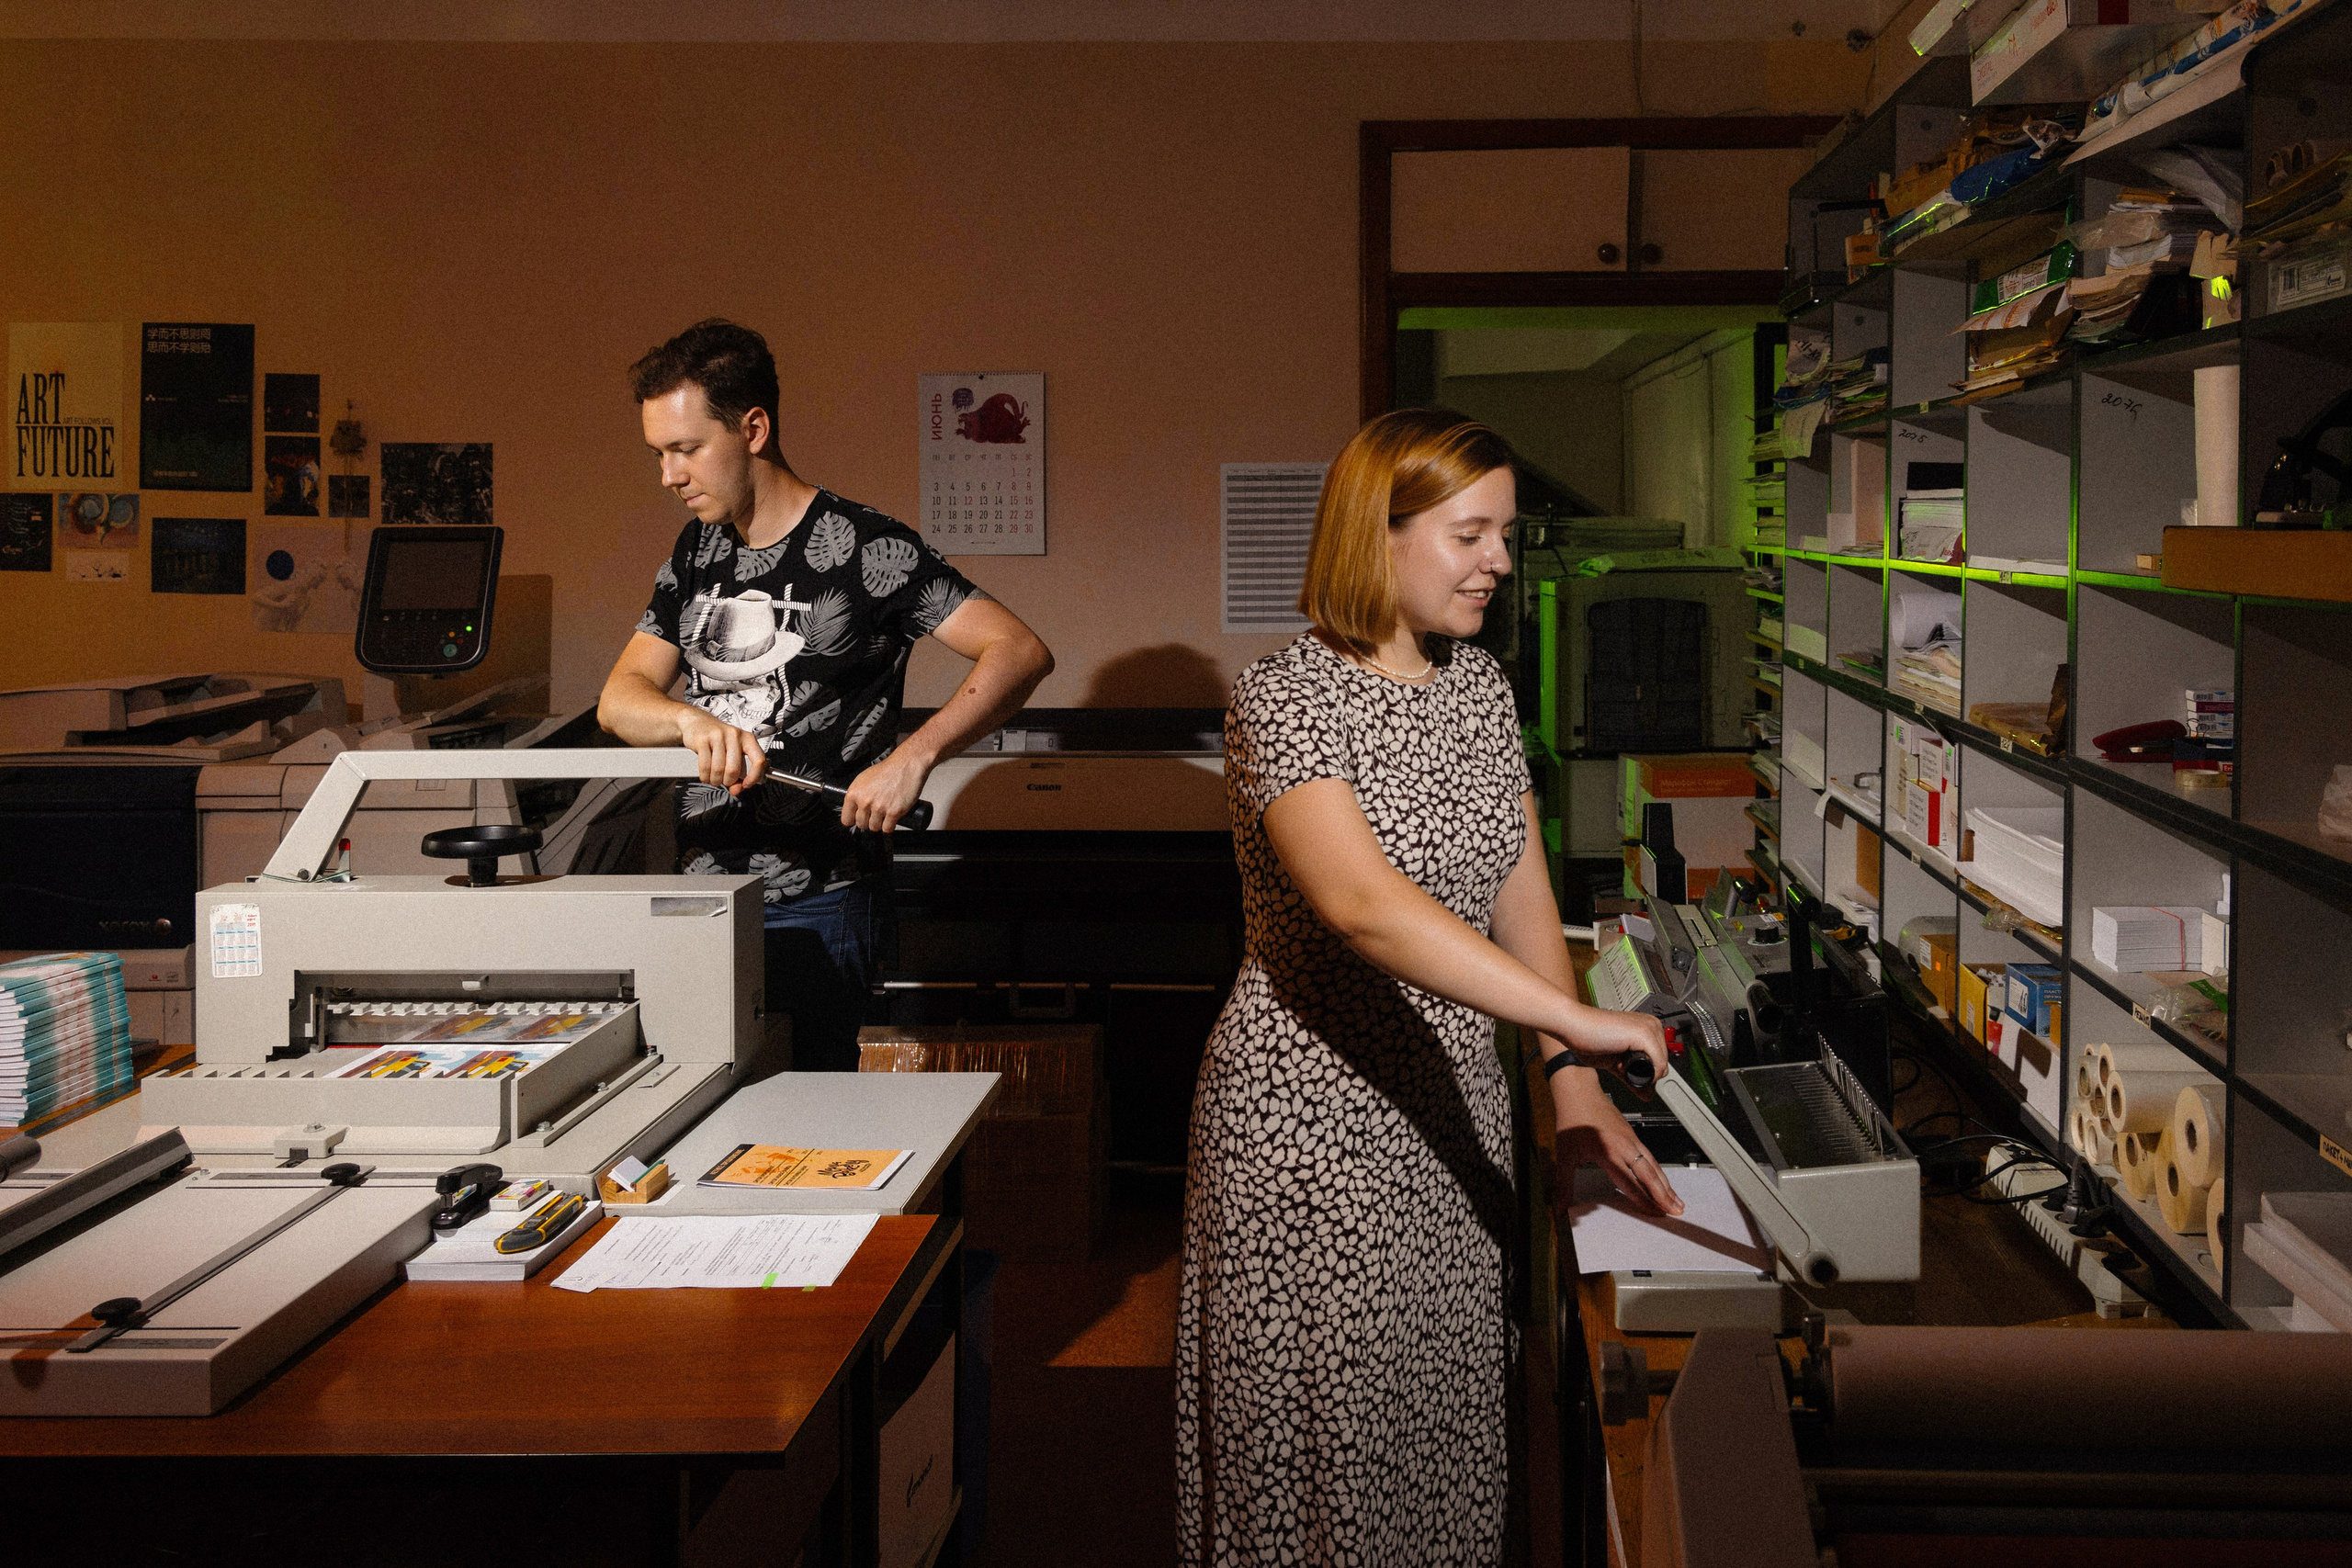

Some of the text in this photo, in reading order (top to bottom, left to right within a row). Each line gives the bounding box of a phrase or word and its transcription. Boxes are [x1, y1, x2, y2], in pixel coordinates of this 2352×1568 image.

[16, 373, 65, 424] ART
[931, 393, 943, 441] ИЮНЬ
[16, 425, 115, 478] FUTURE
[1026, 468, 1032, 477] 2
[933, 482, 940, 491] 3
[965, 482, 971, 491] 5
[980, 482, 987, 491] 6
[996, 481, 1001, 491] 7
[1011, 481, 1017, 491] 8
[1026, 482, 1032, 491] 9
[933, 496, 1033, 505] 10 11 12 13 14 15 16
[933, 510, 1033, 519] 17 18 19 20 21 22 23
[933, 524, 1033, 534] 24 25 26 27 28 29 30
